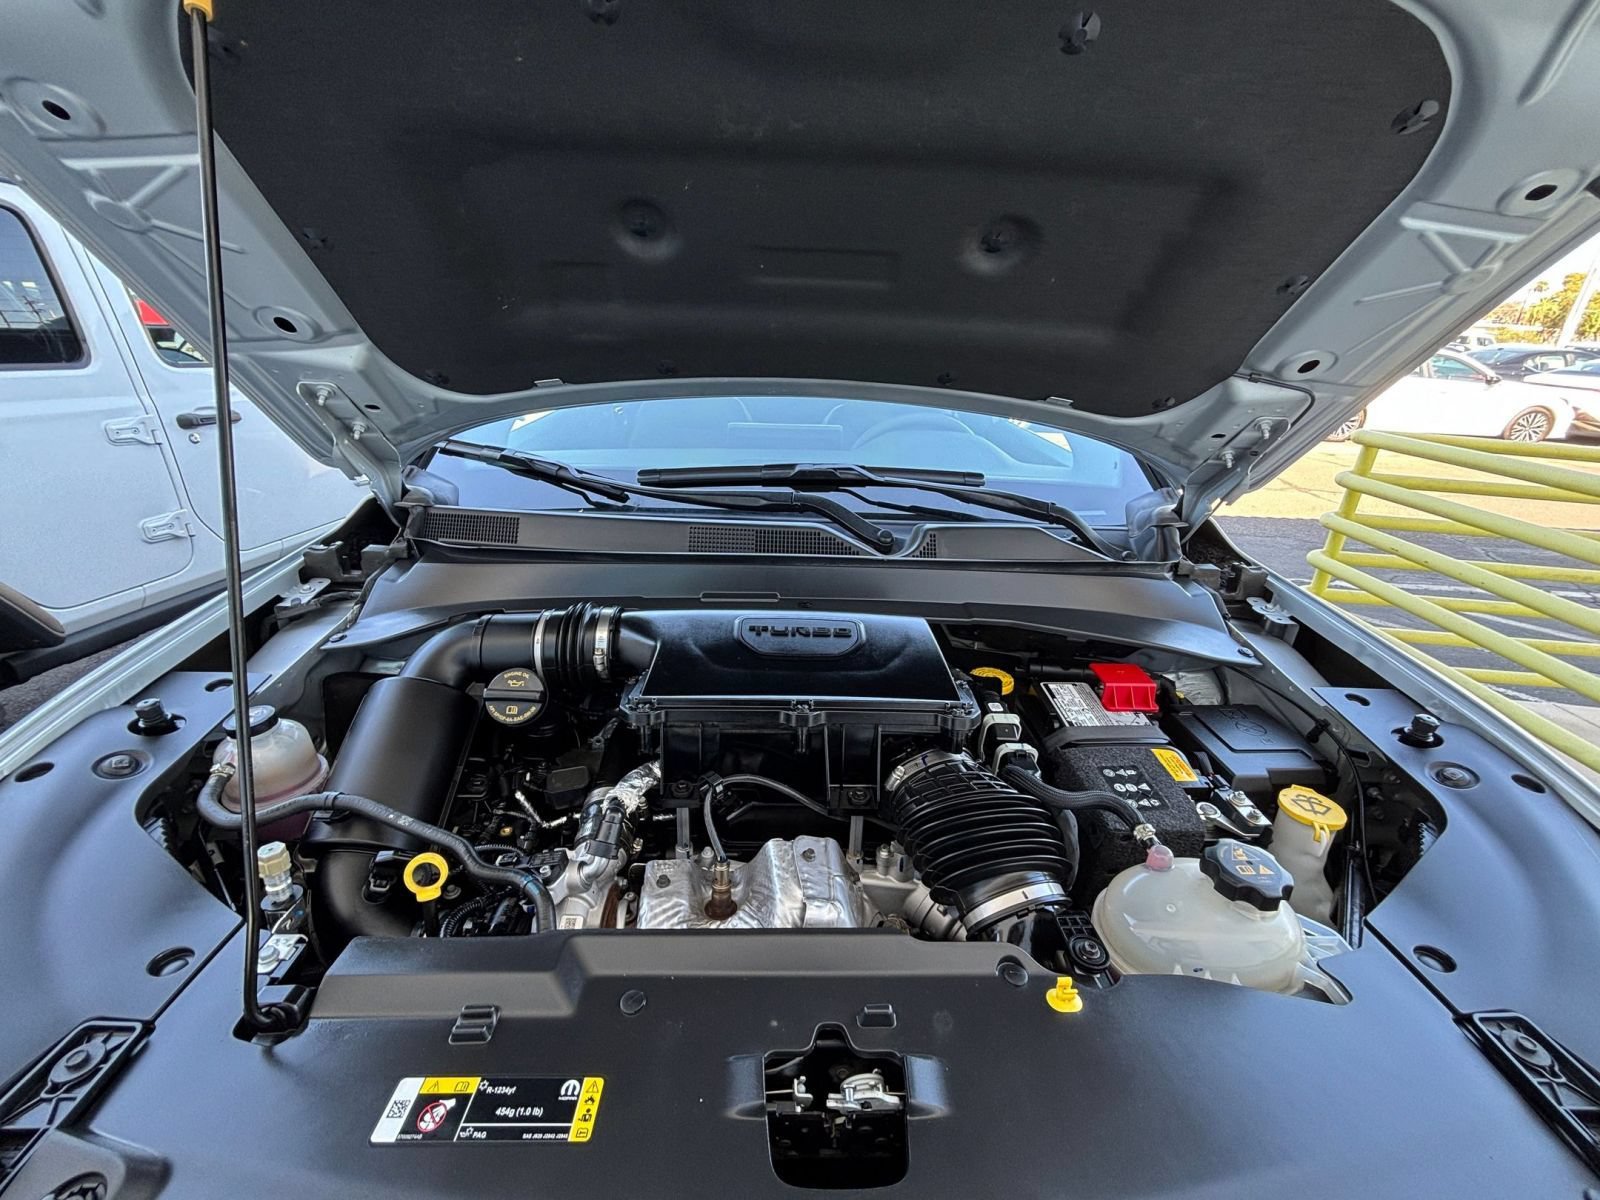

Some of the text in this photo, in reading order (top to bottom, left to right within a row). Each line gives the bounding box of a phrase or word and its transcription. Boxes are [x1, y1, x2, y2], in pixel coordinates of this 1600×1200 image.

[748, 625, 852, 638] TURBO
[486, 1086, 516, 1095] R-1234yf
[495, 1107, 544, 1118] 454g (1.0 lb)
[472, 1131, 487, 1139] PAG
